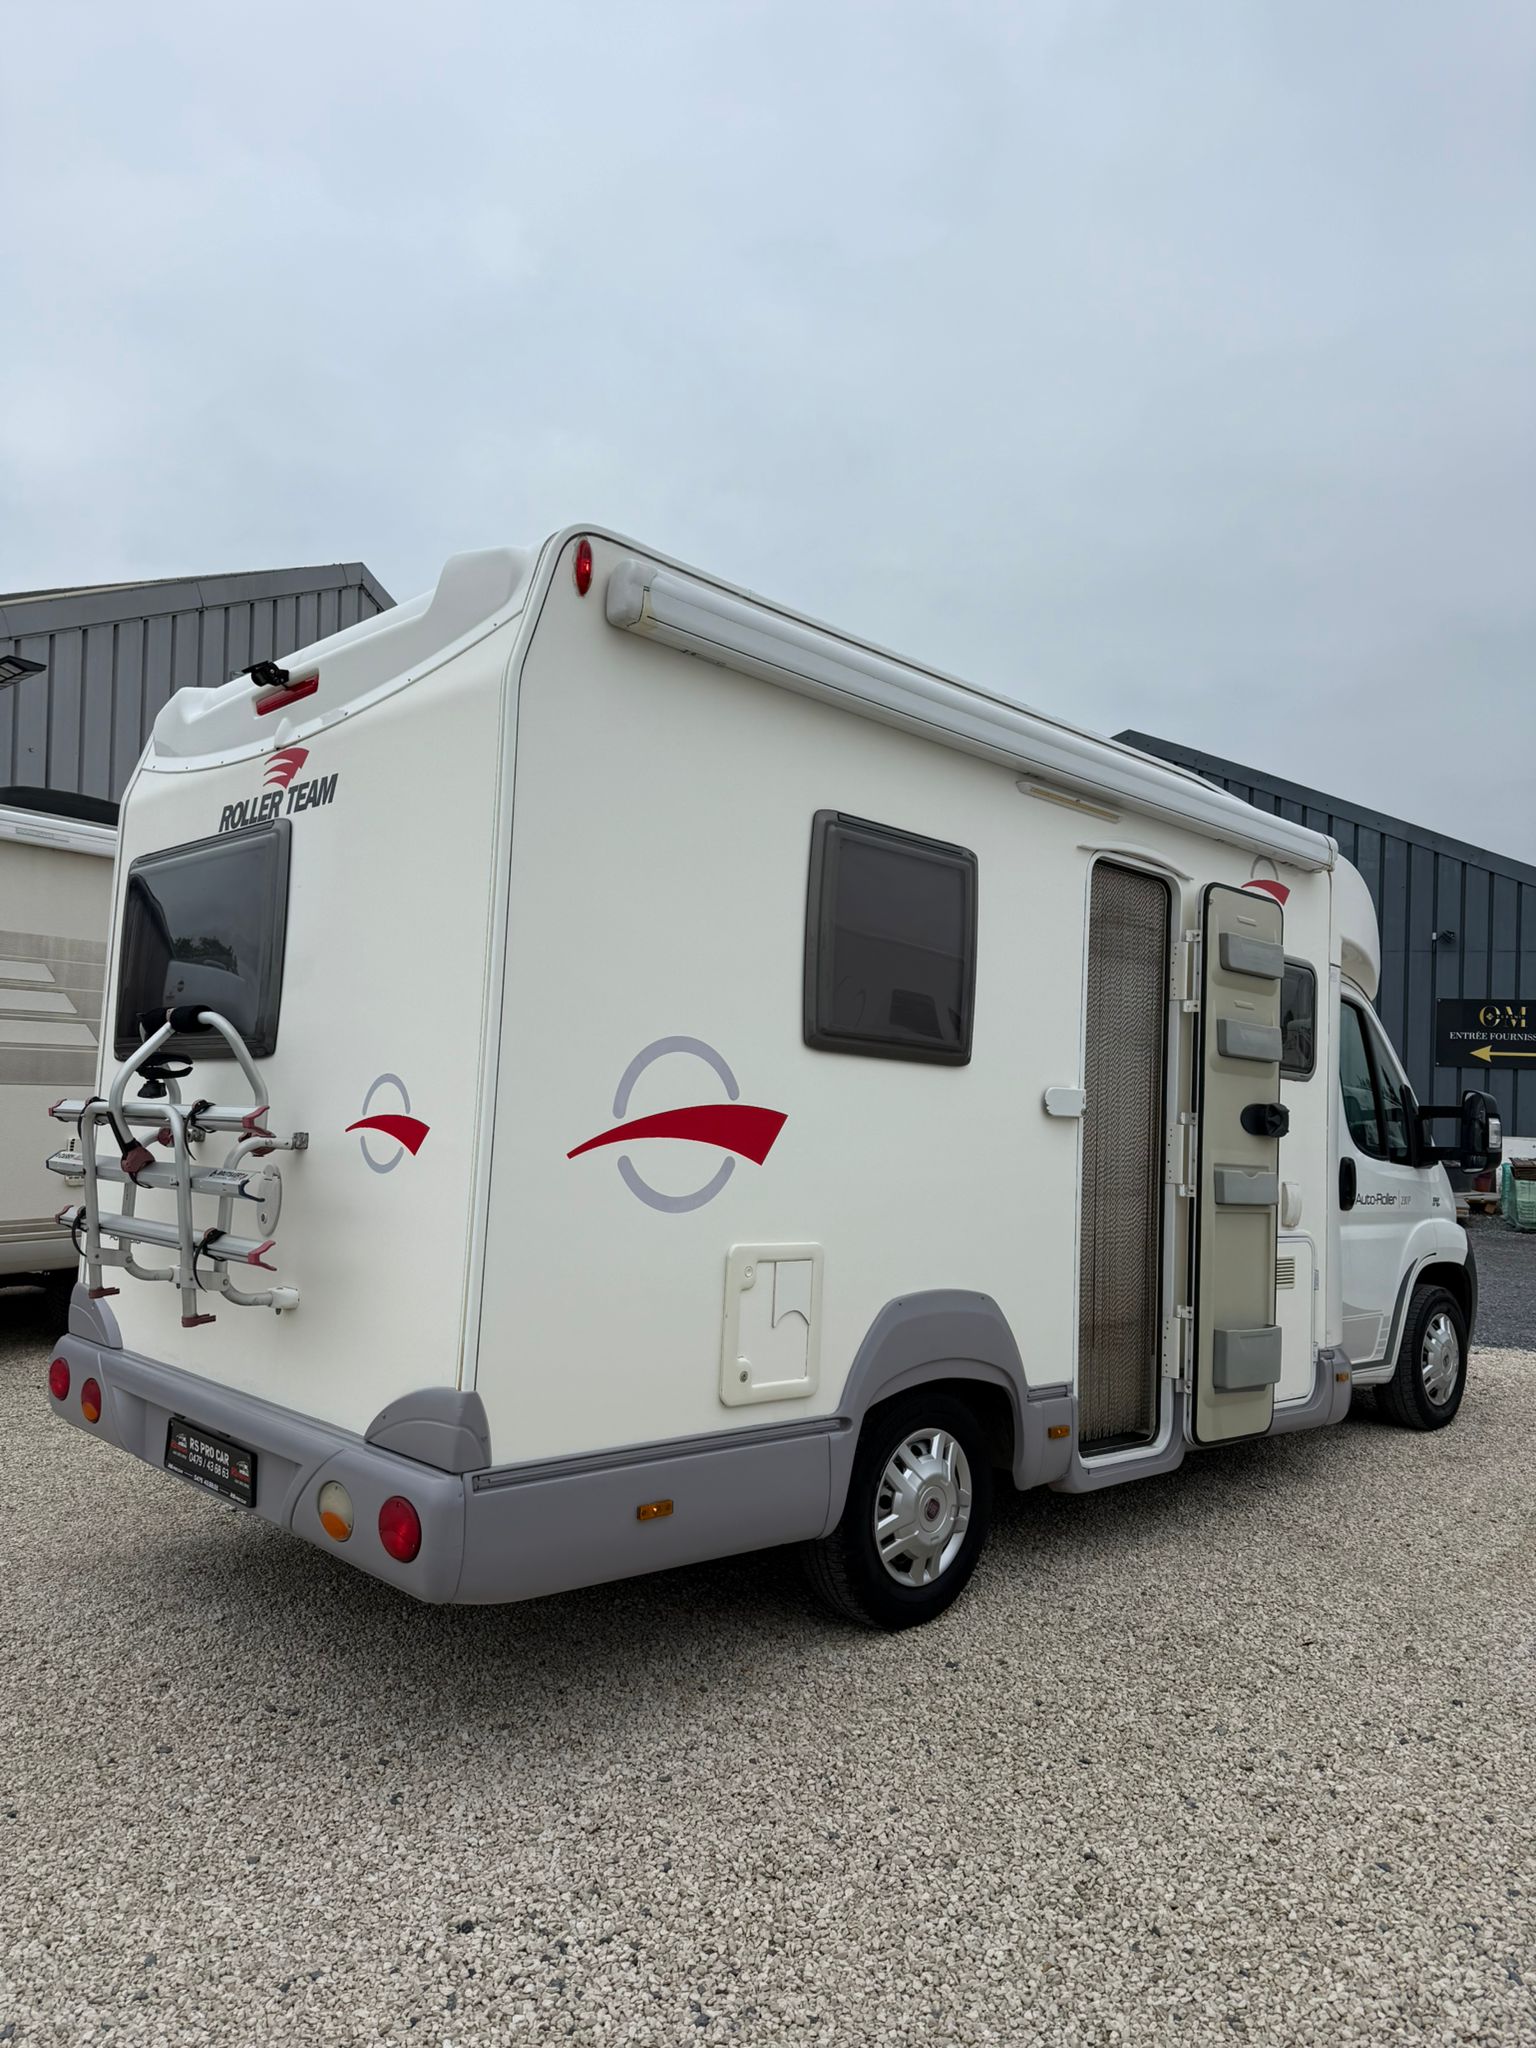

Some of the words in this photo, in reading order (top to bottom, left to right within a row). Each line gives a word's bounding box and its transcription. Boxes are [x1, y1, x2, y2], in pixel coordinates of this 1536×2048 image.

[218, 789, 284, 833] ROLLER
[286, 772, 339, 815] TEAM
[1449, 1031, 1488, 1040] ENTRÉE
[189, 1437, 199, 1452] RS
[200, 1441, 215, 1459] PRO
[215, 1449, 230, 1466] CAR
